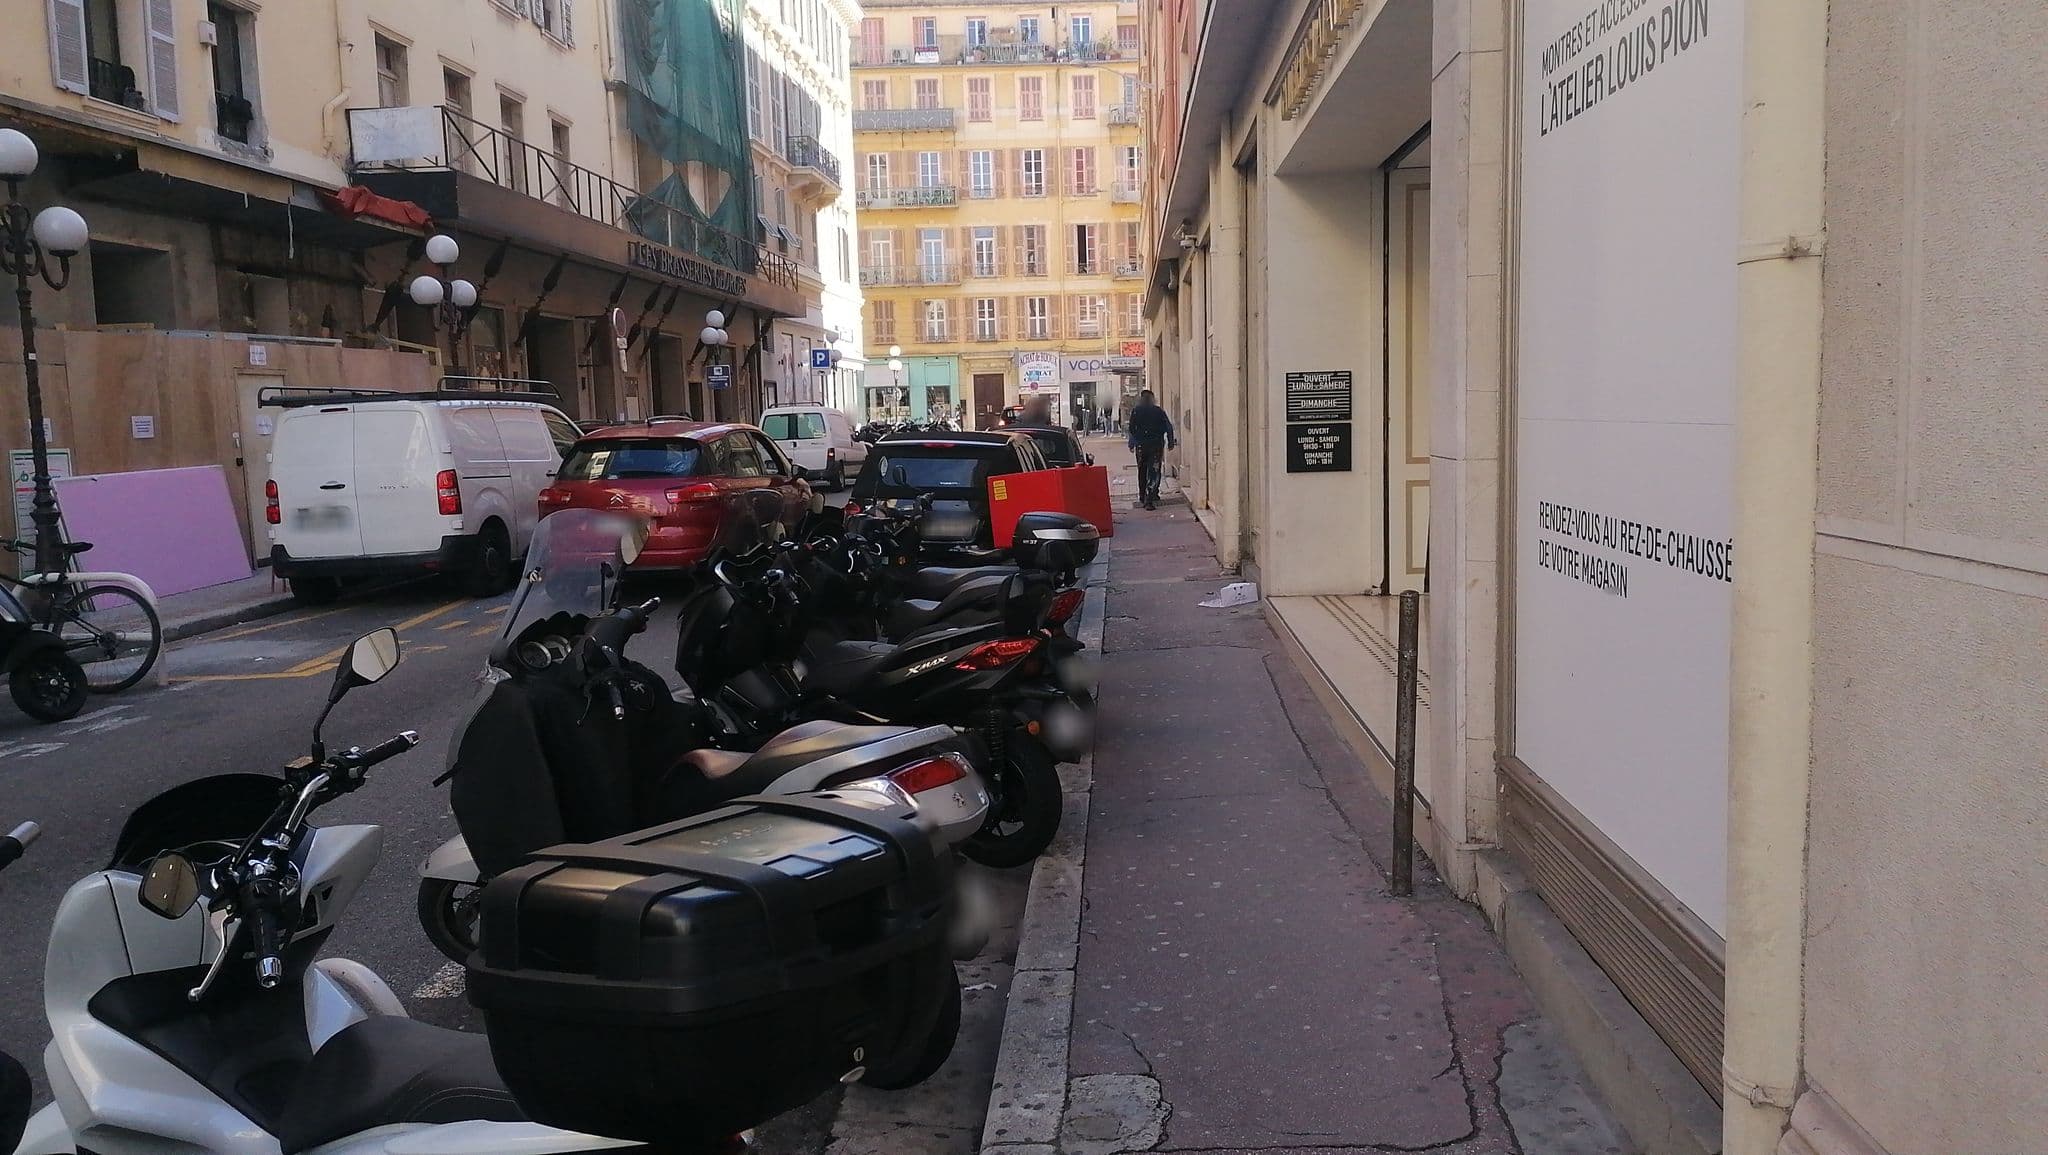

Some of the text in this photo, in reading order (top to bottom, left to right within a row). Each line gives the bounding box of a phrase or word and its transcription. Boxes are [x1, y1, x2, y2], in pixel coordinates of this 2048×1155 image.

[1541, 21, 1583, 80] MONTRES
[1585, 10, 1598, 47] ET
[1540, 0, 1709, 137] L'ATELIER LOUIS PION
[816, 353, 826, 365] P
[1304, 375, 1331, 383] OUVERT
[1292, 380, 1347, 391] LUNDI SAMEDI
[1300, 399, 1337, 408] DIMANCHE
[1297, 436, 1315, 444] LUNDI
[1538, 500, 1601, 544] RENDEZ-VOUS
[1602, 515, 1618, 549] AU
[1538, 539, 1629, 598] DE VOTRE MAGASIN
